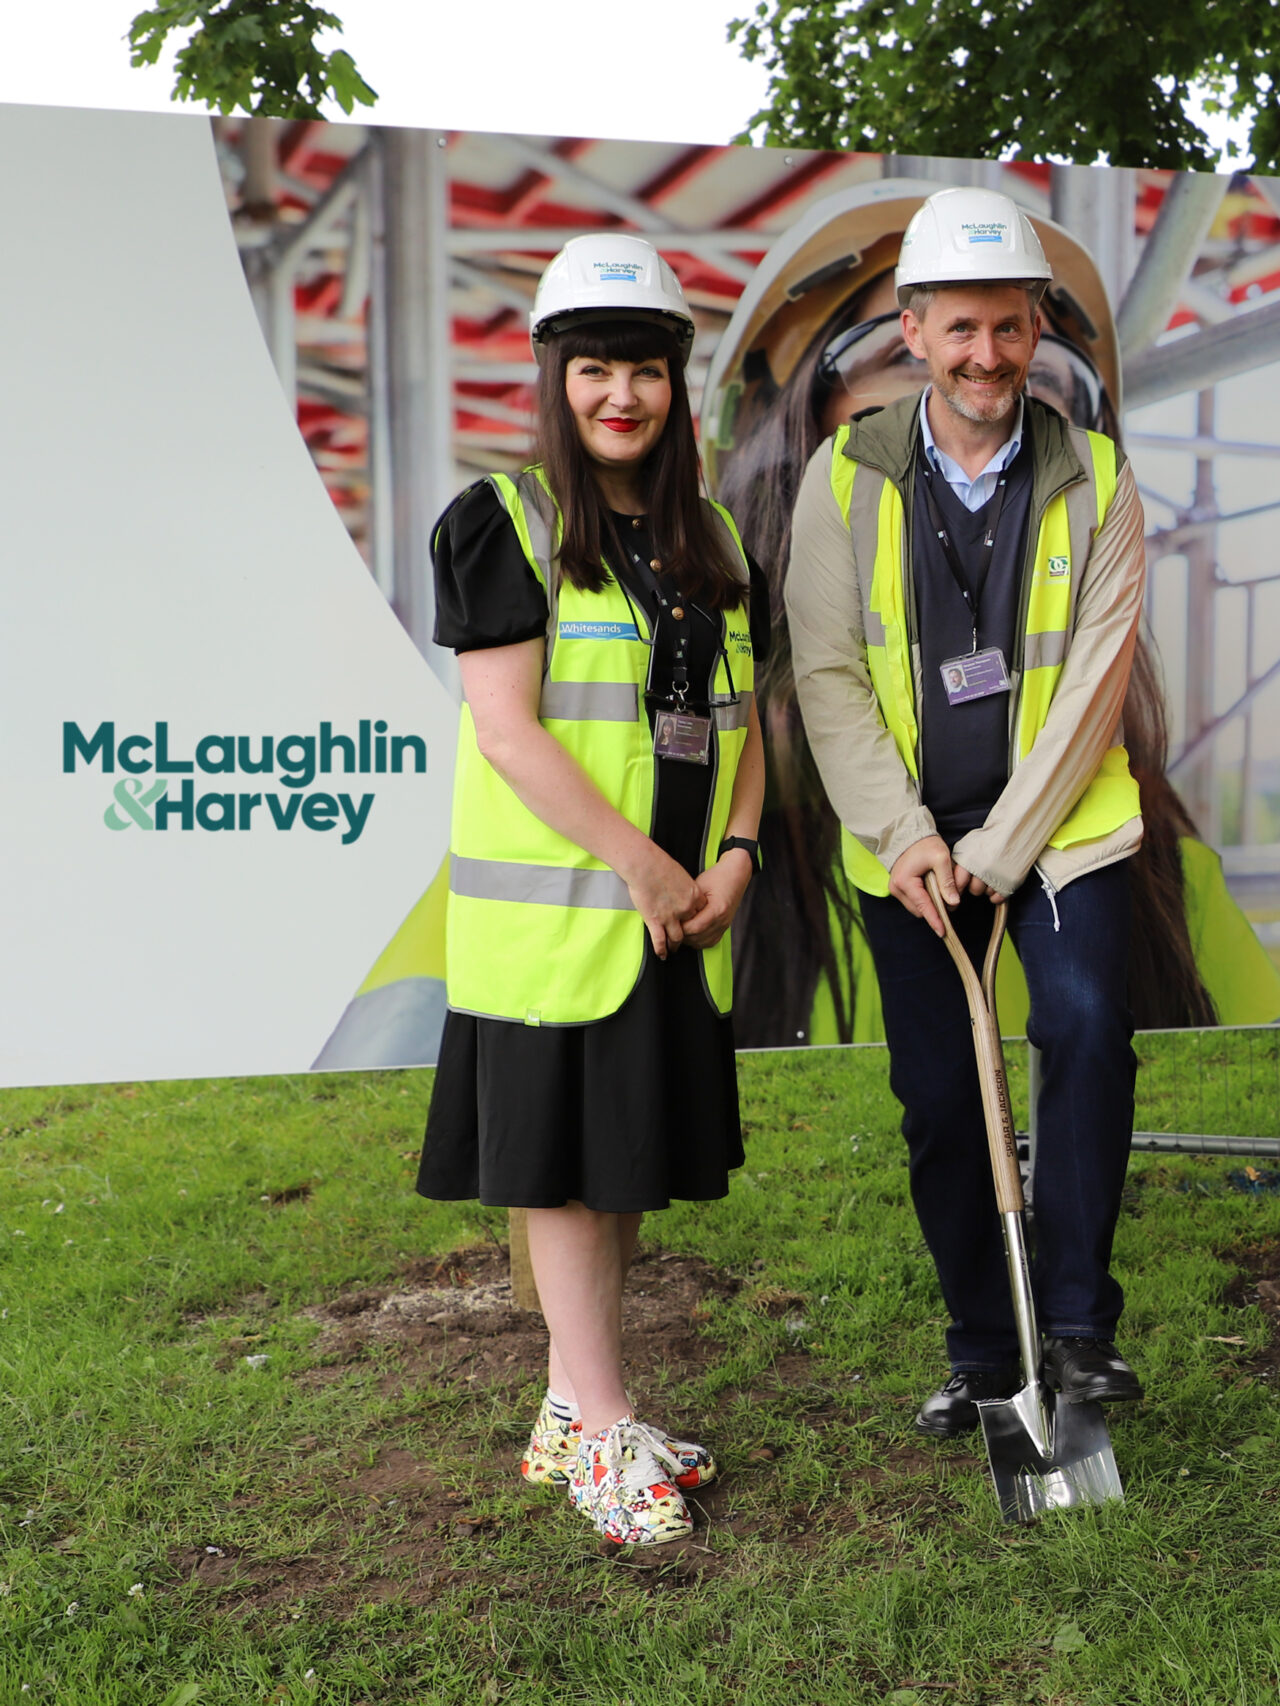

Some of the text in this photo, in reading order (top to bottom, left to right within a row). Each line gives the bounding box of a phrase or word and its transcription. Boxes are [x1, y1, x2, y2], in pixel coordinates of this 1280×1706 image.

[562, 623, 621, 633] Whitesands
[63, 720, 426, 788] McLaughlin
[104, 778, 376, 845] &Harvey
[995, 1069, 1007, 1114] JACKSON
[1003, 1126, 1014, 1157] SPEAR
